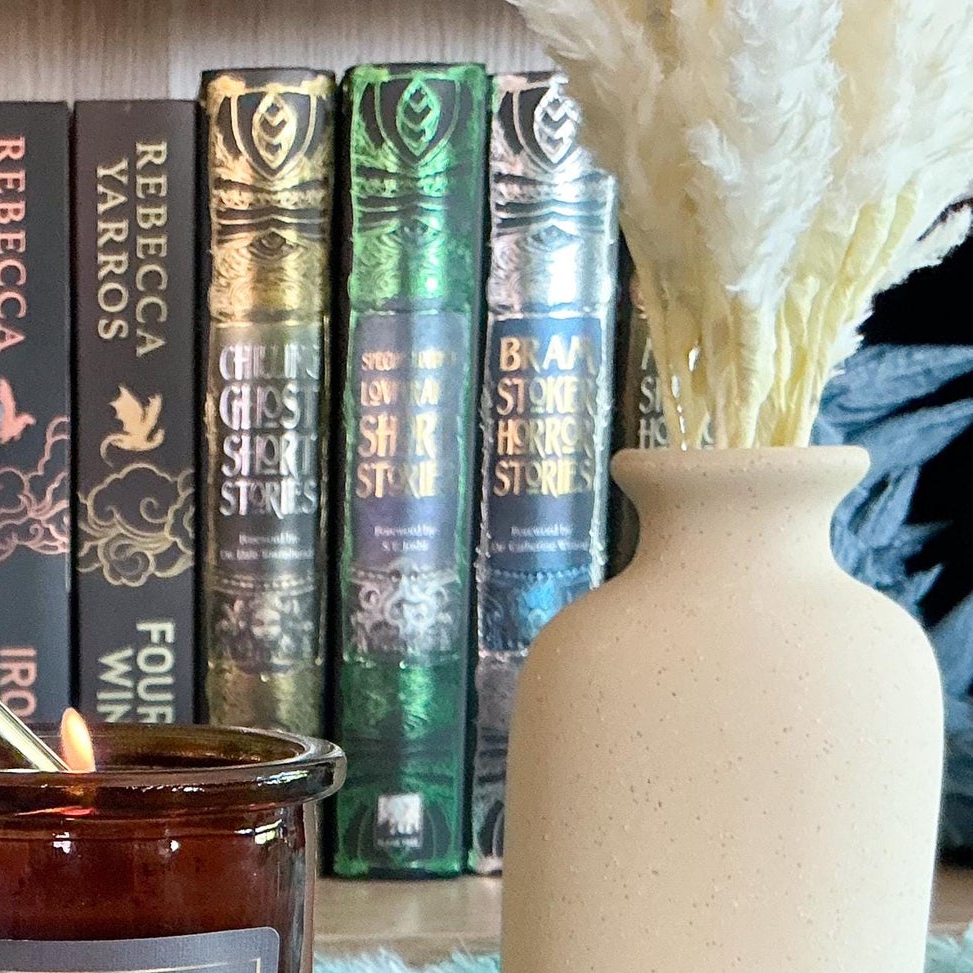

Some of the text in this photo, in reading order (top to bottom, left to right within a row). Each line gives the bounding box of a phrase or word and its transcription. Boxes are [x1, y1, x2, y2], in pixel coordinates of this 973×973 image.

[96, 158, 129, 340] YARROS
[135, 141, 168, 358] REBECCA
[498, 335, 597, 374] BRAM
[219, 381, 320, 431] GHOST
[496, 375, 596, 417] STOKER
[221, 430, 318, 478] SHORT
[497, 416, 594, 459] HORROR
[219, 477, 318, 519] STORIES
[493, 458, 594, 498] STORIES
